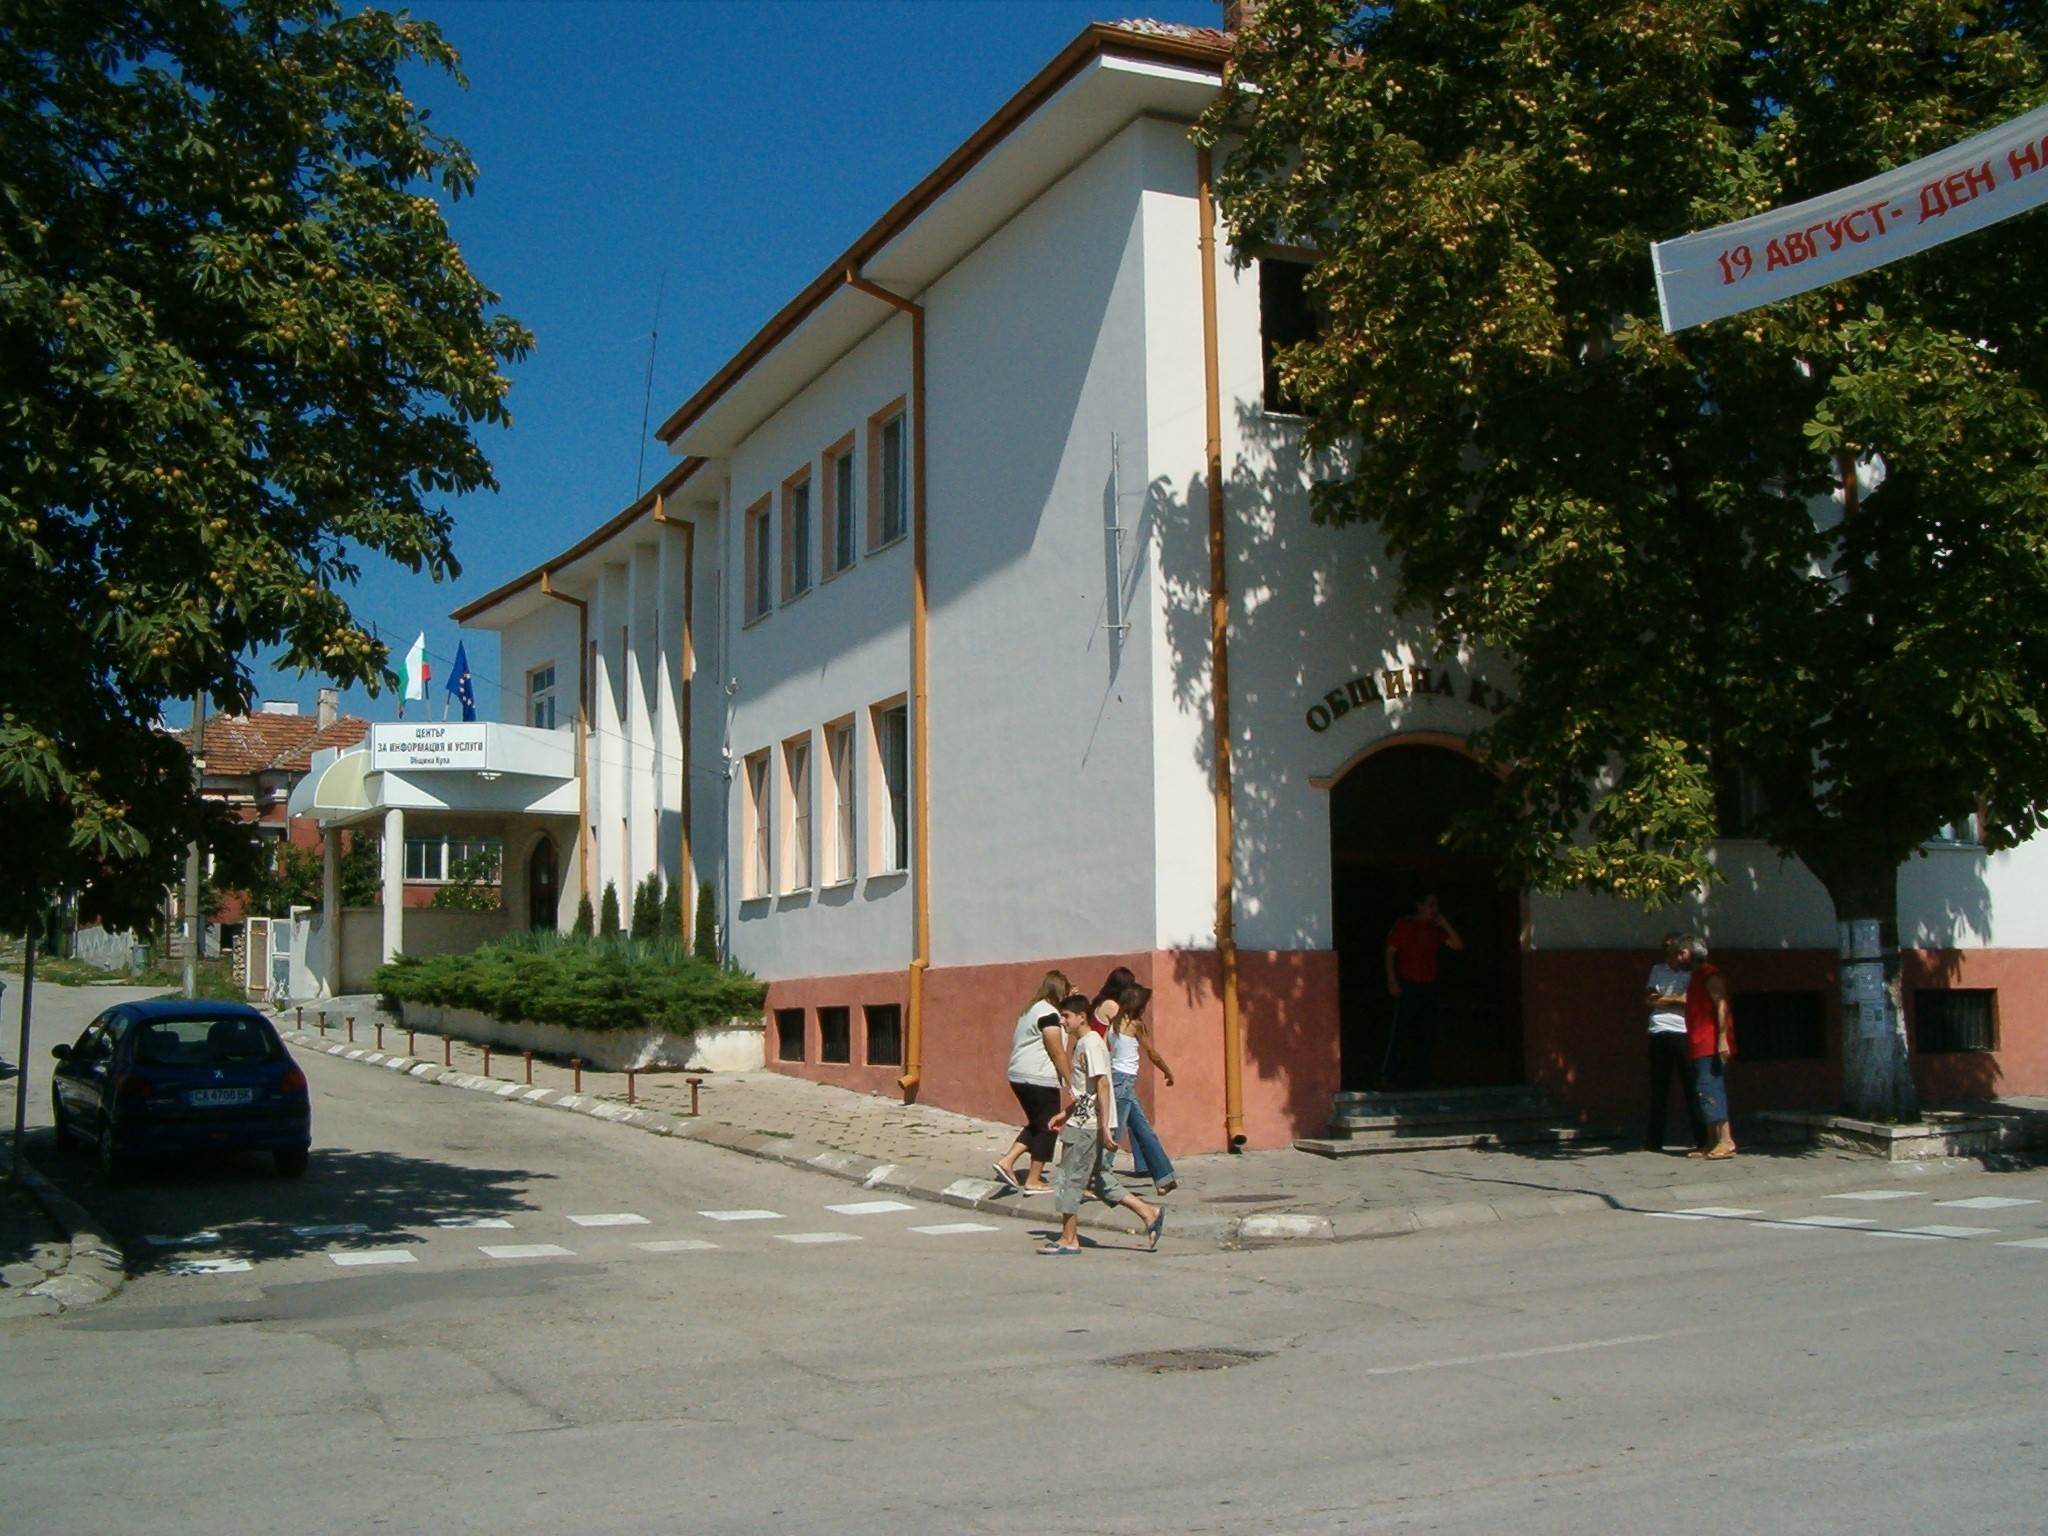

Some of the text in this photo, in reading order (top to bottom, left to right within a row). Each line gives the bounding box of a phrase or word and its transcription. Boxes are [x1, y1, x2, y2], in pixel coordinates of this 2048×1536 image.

[1718, 246, 1753, 285] 19
[1918, 160, 1996, 224] ДЕН
[1306, 668, 1455, 732] ОБЩИНА
[377, 742, 387, 751] ЗА
[389, 742, 445, 753] ИНФОРМАЦИЯ
[455, 742, 483, 751] УСЛУГИ
[415, 728, 446, 738] ЦЕНТЪР
